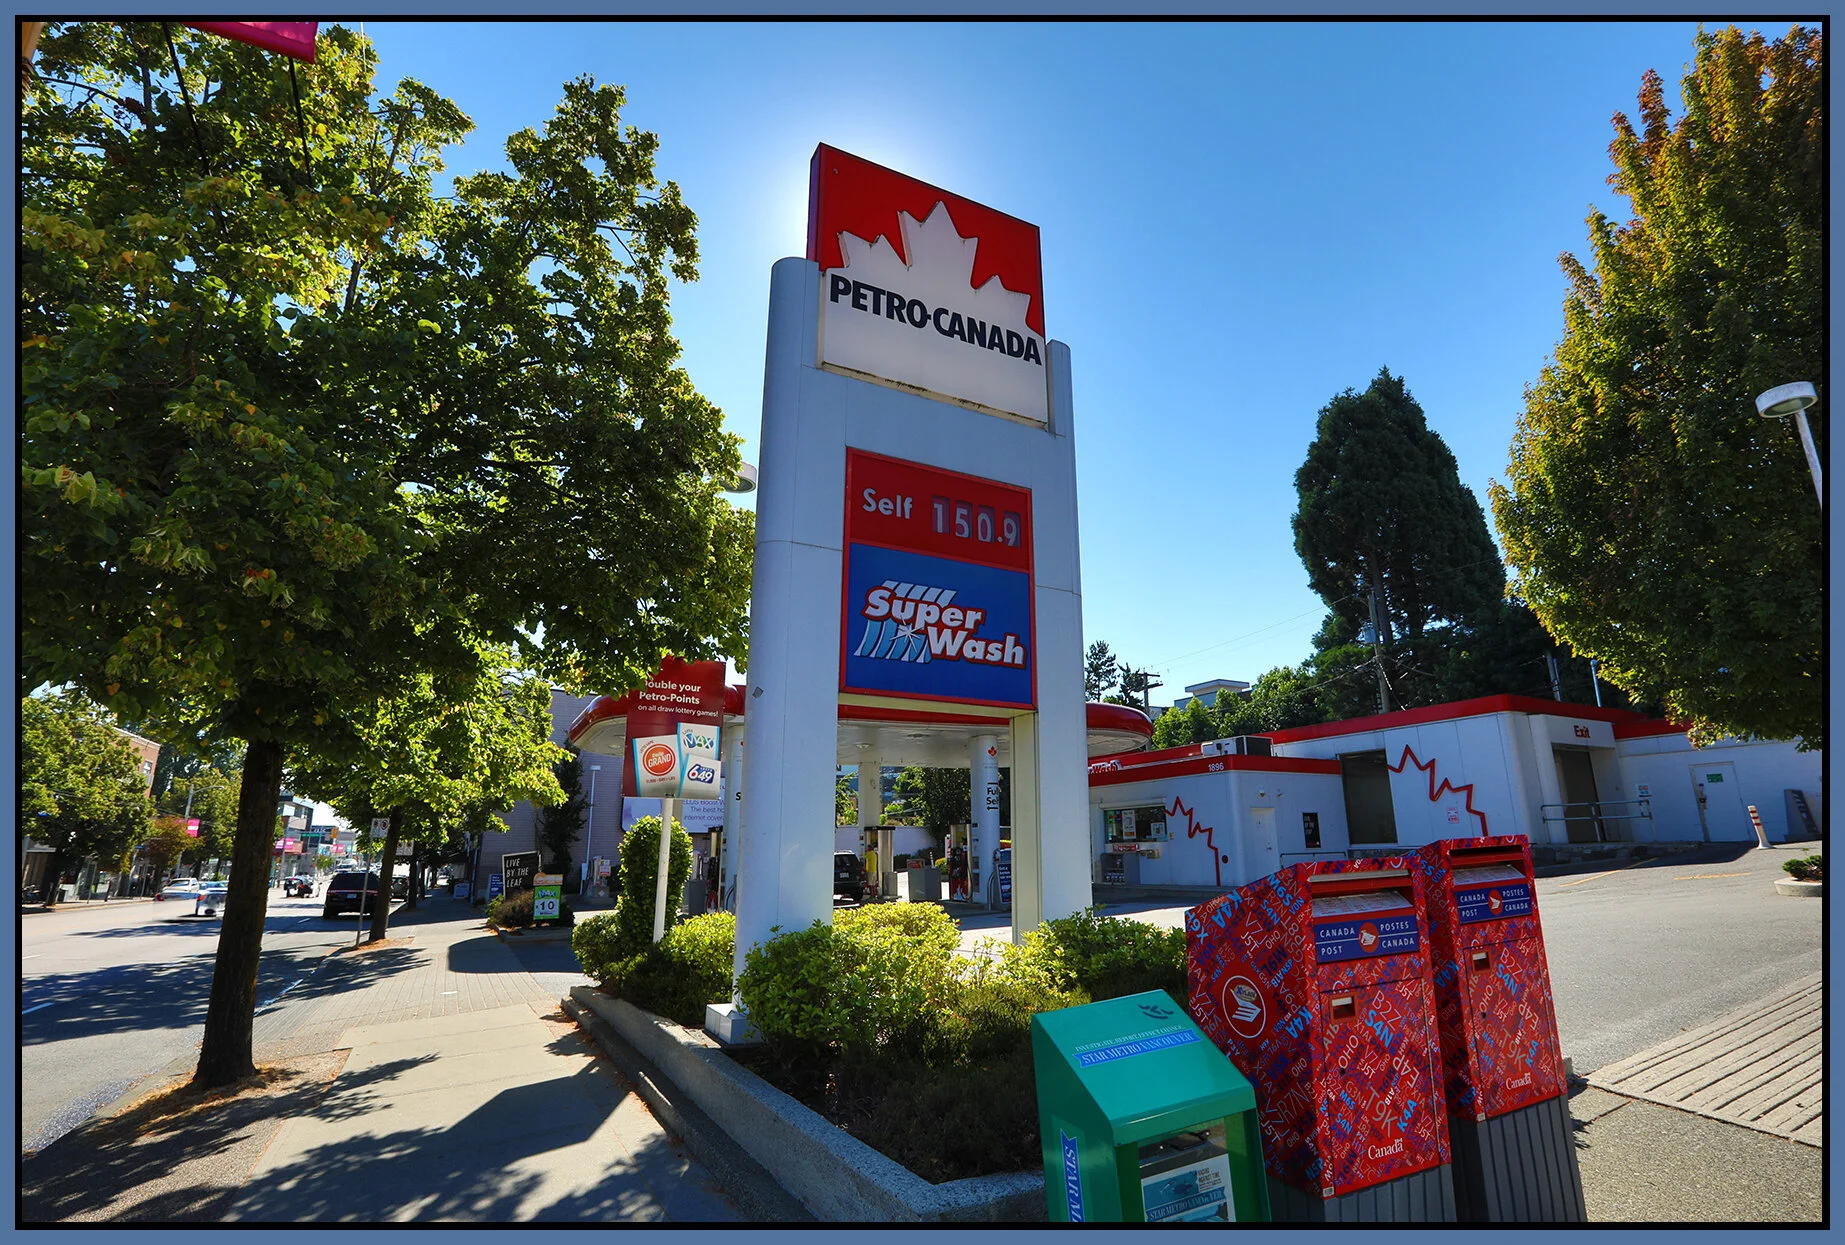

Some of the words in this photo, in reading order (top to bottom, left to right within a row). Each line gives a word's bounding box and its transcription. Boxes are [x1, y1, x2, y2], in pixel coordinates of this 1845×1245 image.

[829, 273, 1043, 367] PETRO-CANADA
[862, 488, 913, 519] Self
[933, 502, 1018, 547] 150.9
[865, 588, 983, 630] Super
[927, 627, 1026, 665] Wash
[639, 691, 700, 705] Petro-Points
[679, 684, 702, 693] your
[657, 705, 675, 713] draw
[675, 707, 696, 716] lottery
[683, 733, 714, 750] MAX
[1574, 725, 1591, 738] Exit
[648, 753, 672, 768] GRAND
[1208, 763, 1225, 772] 1896
[691, 806, 703, 815] The
[703, 806, 717, 815] best
[506, 859, 520, 868] LIVE
[506, 869, 515, 877] BY
[517, 867, 529, 876] THE
[506, 878, 522, 887] LEAF
[1268, 873, 1294, 907] M6S
[1460, 893, 1486, 903] CANADA
[1502, 888, 1524, 898] POSTES
[1211, 888, 1244, 928] K4A
[1261, 899, 1281, 925] S4N
[1462, 908, 1478, 918] POST
[1504, 902, 1528, 912] CANADA
[1320, 927, 1356, 938] CANADA
[1380, 920, 1410, 932] POSTES
[1240, 931, 1260, 952] J5T
[1321, 945, 1343, 956] POST
[1381, 938, 1416, 948] CANADA
[1433, 959, 1460, 988] K4A
[1500, 947, 1523, 982] B2Z
[1496, 963, 1518, 996] S4N
[1284, 1005, 1314, 1039] K4A
[1371, 989, 1403, 1033] B2Z
[1364, 1008, 1395, 1049] S4N
[1081, 1051, 1111, 1064] STAR
[1106, 1041, 1141, 1058] METRO
[1139, 1031, 1194, 1052] VANCOUVER
[1500, 1028, 1527, 1072] T9K
[1525, 1039, 1539, 1069] K4A
[1360, 1062, 1376, 1080] J5T
[1392, 1053, 1421, 1089] E4P
[1505, 1072, 1532, 1091] Canada
[1339, 1088, 1356, 1111] M6S
[1384, 1087, 1396, 1106] A1B
[1335, 1112, 1353, 1135] S4N
[1364, 1085, 1399, 1139] T9K
[1396, 1098, 1418, 1133] K4A
[1367, 1138, 1404, 1160] Canada
[1065, 1146, 1079, 1198] STAR
